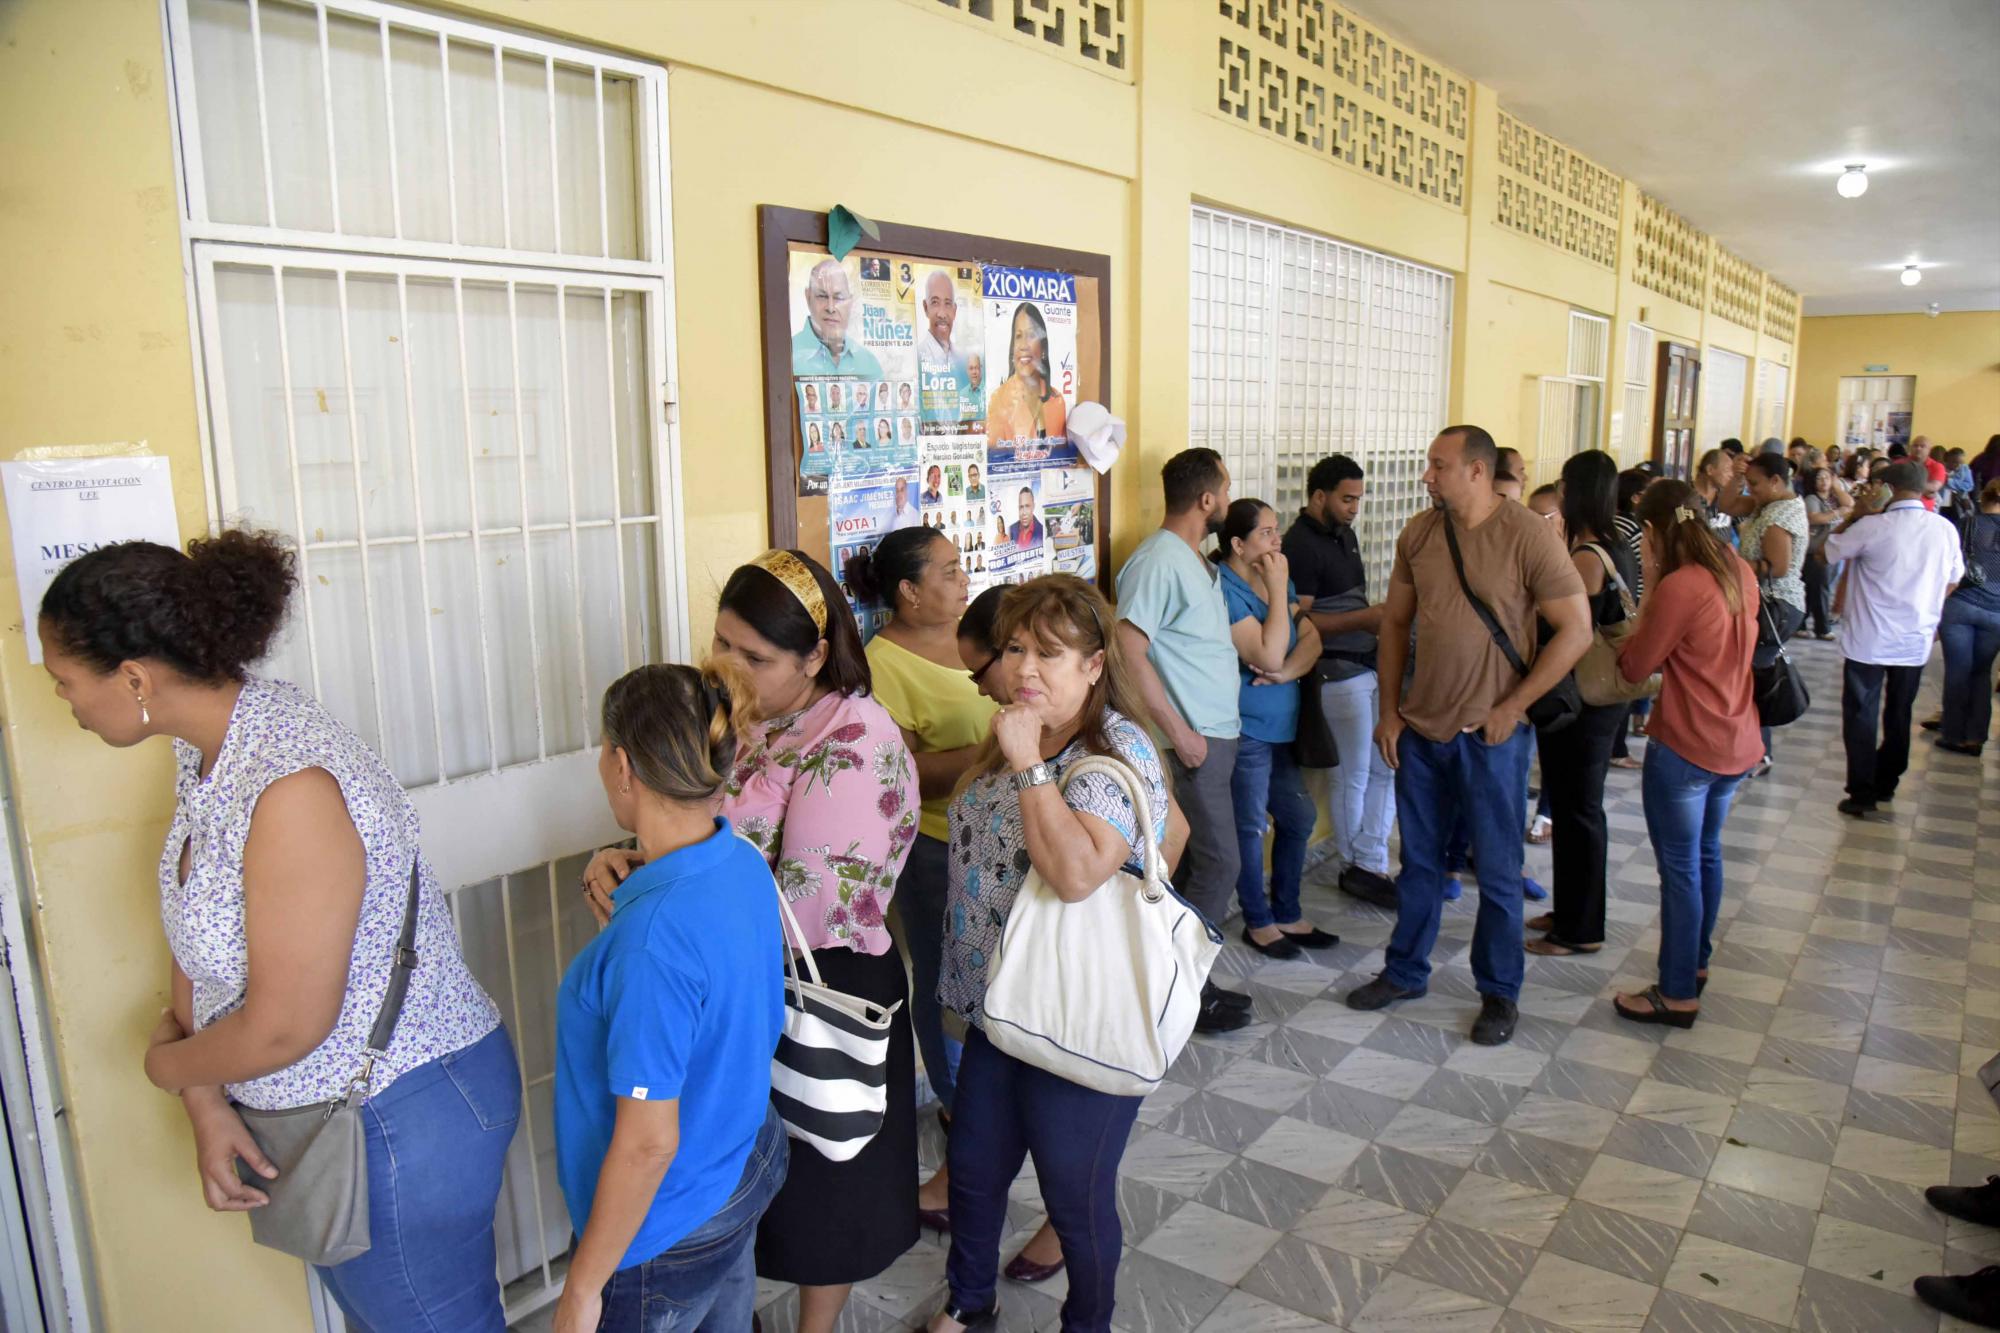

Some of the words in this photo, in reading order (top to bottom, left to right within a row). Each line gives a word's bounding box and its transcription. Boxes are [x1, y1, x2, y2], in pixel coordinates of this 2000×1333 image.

[901, 264, 911, 282] 3
[976, 271, 982, 283] 3
[988, 273, 1071, 302] XIOMARA
[863, 303, 885, 317] Juan
[1044, 304, 1071, 316] Guante
[864, 317, 912, 340] Núñez
[921, 362, 951, 375] Miguel
[922, 373, 956, 391] Lora
[1063, 371, 1072, 394] 2
[31, 481, 72, 490] CENTRO
[75, 480, 88, 488] DE
[91, 477, 141, 487] VOTACION
[835, 518, 870, 532] VOTA
[872, 516, 877, 528] 1
